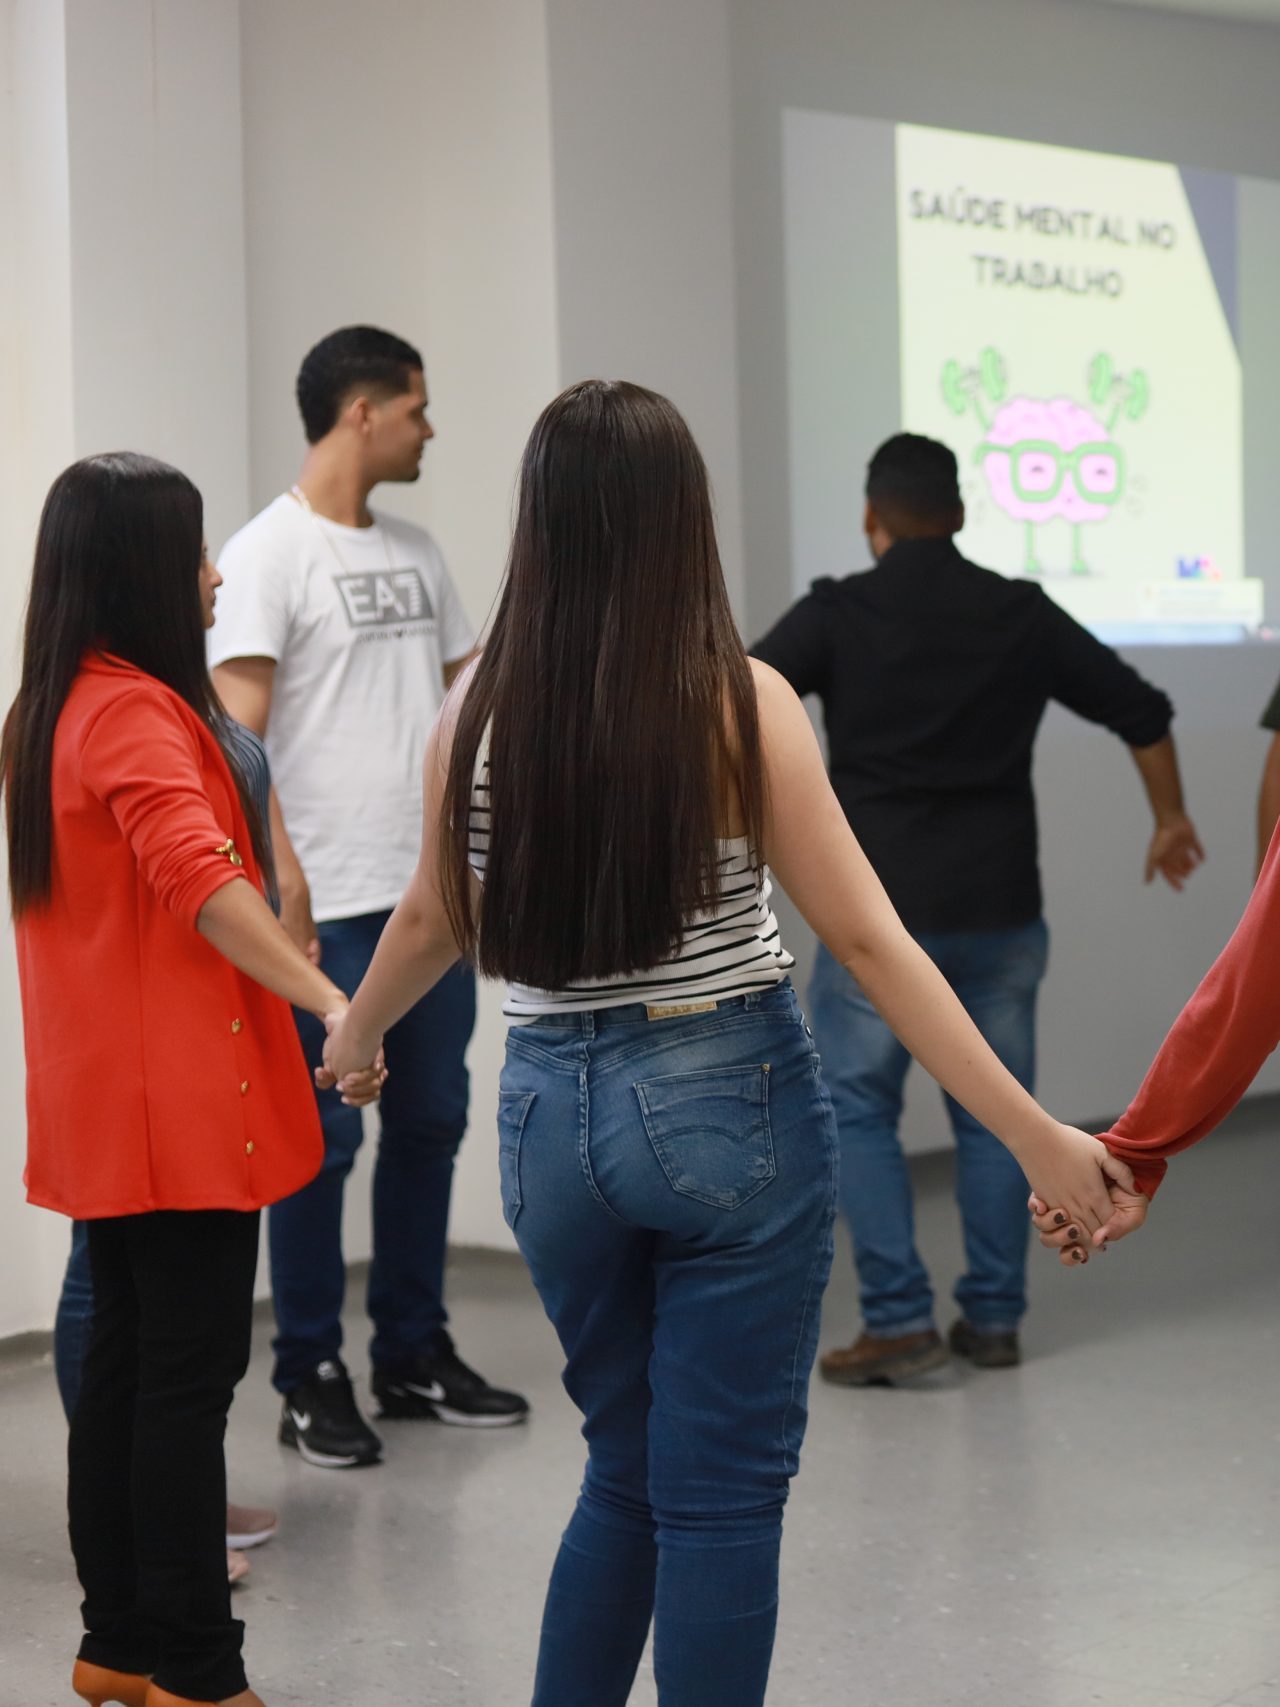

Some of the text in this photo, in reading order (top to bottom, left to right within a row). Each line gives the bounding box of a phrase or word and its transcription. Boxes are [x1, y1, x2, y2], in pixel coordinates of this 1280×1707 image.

[910, 185, 1177, 250] SAÚDE MENTAL NO
[972, 253, 1122, 298] TRABALHO
[338, 571, 422, 624] EA7
